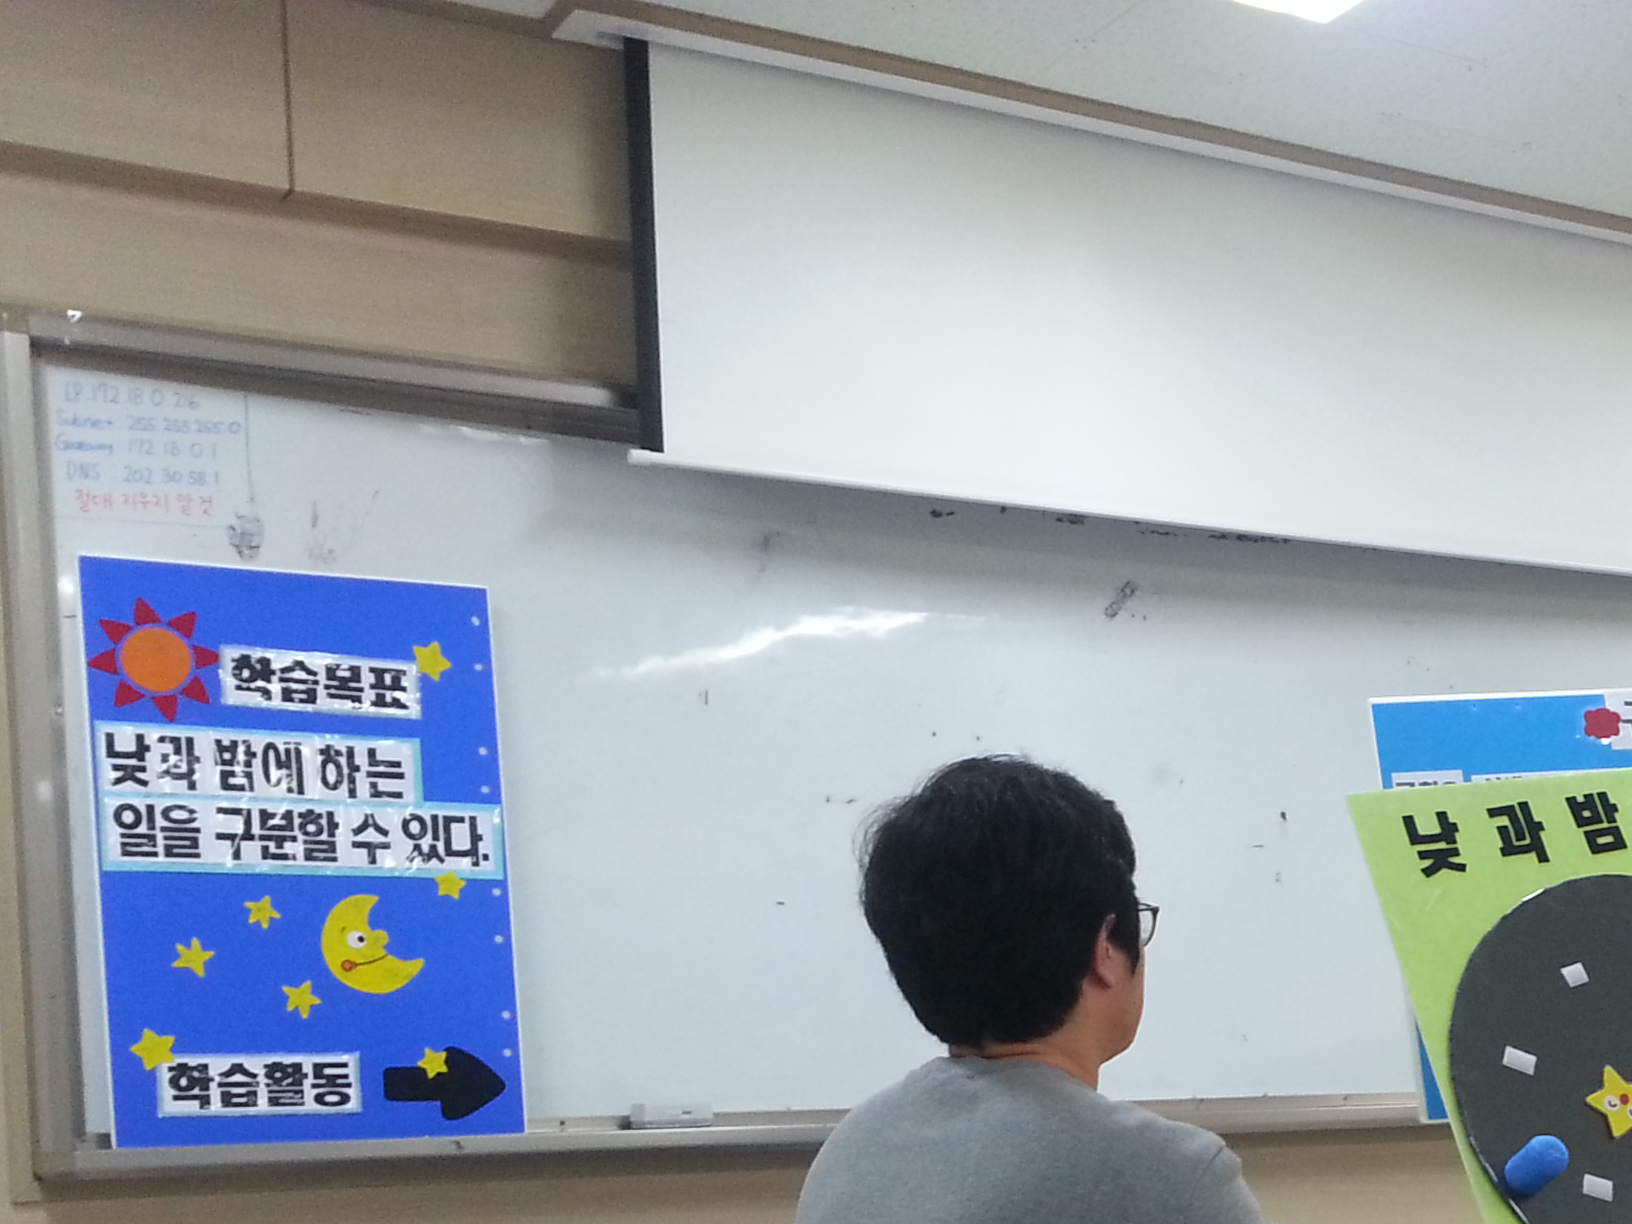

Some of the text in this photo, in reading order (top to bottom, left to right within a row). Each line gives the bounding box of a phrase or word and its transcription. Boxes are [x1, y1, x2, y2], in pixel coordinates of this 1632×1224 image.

[230, 652, 410, 711] 학습목표
[103, 730, 407, 801] 낮과 밤에 하는
[112, 802, 491, 868] 일을 구분할 수 있다.
[166, 1061, 353, 1111] 학습활동
